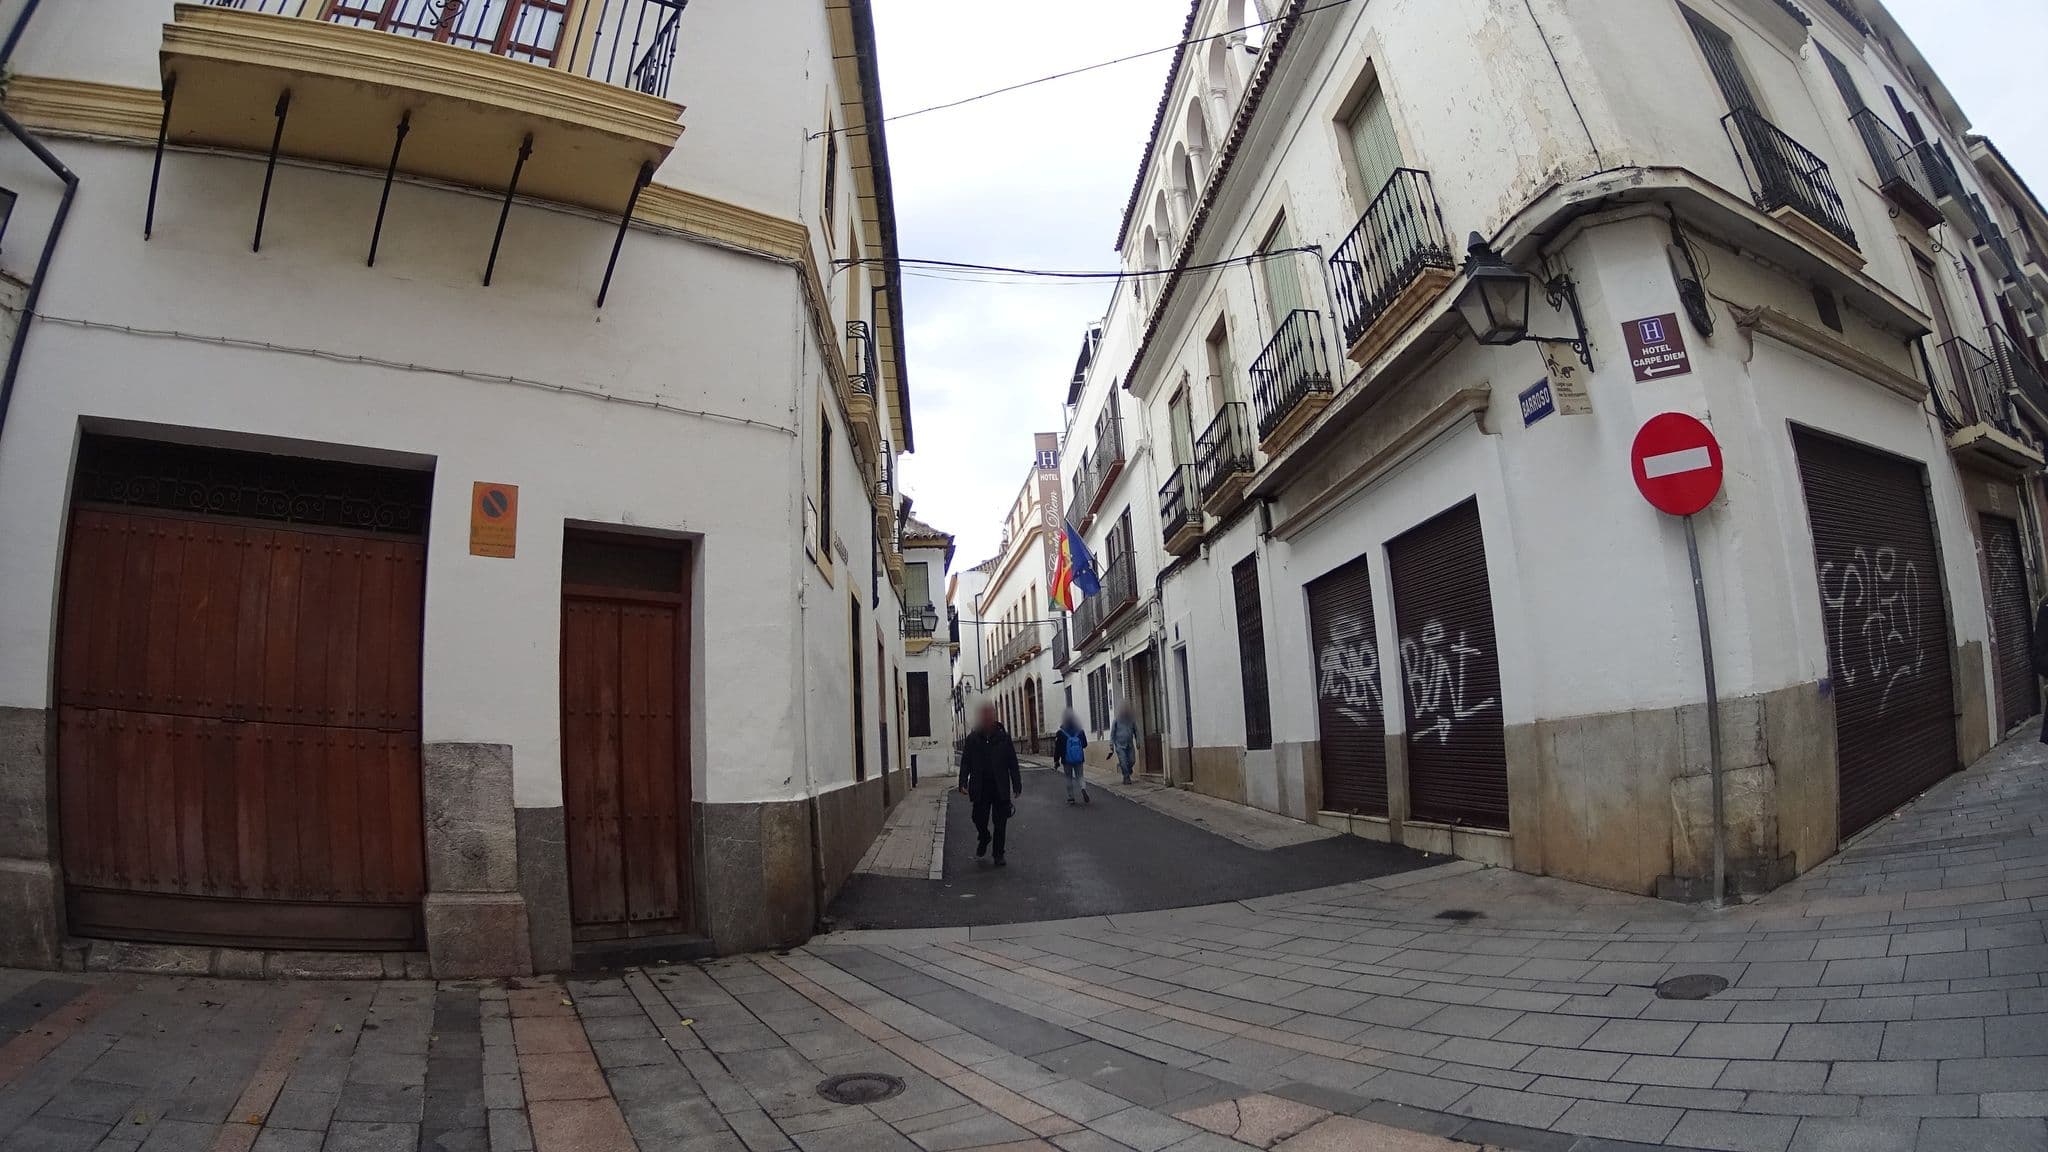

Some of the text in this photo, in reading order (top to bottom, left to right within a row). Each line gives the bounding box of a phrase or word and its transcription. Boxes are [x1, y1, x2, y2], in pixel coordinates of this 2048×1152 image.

[1642, 321, 1662, 341] H
[1642, 344, 1672, 356] HOTEL
[1633, 351, 1686, 368] CARPE DIEM
[1522, 387, 1550, 418] BARROSO
[1041, 451, 1055, 466] H
[1040, 473, 1059, 481] HOTEL
[1045, 490, 1060, 528] Diem
